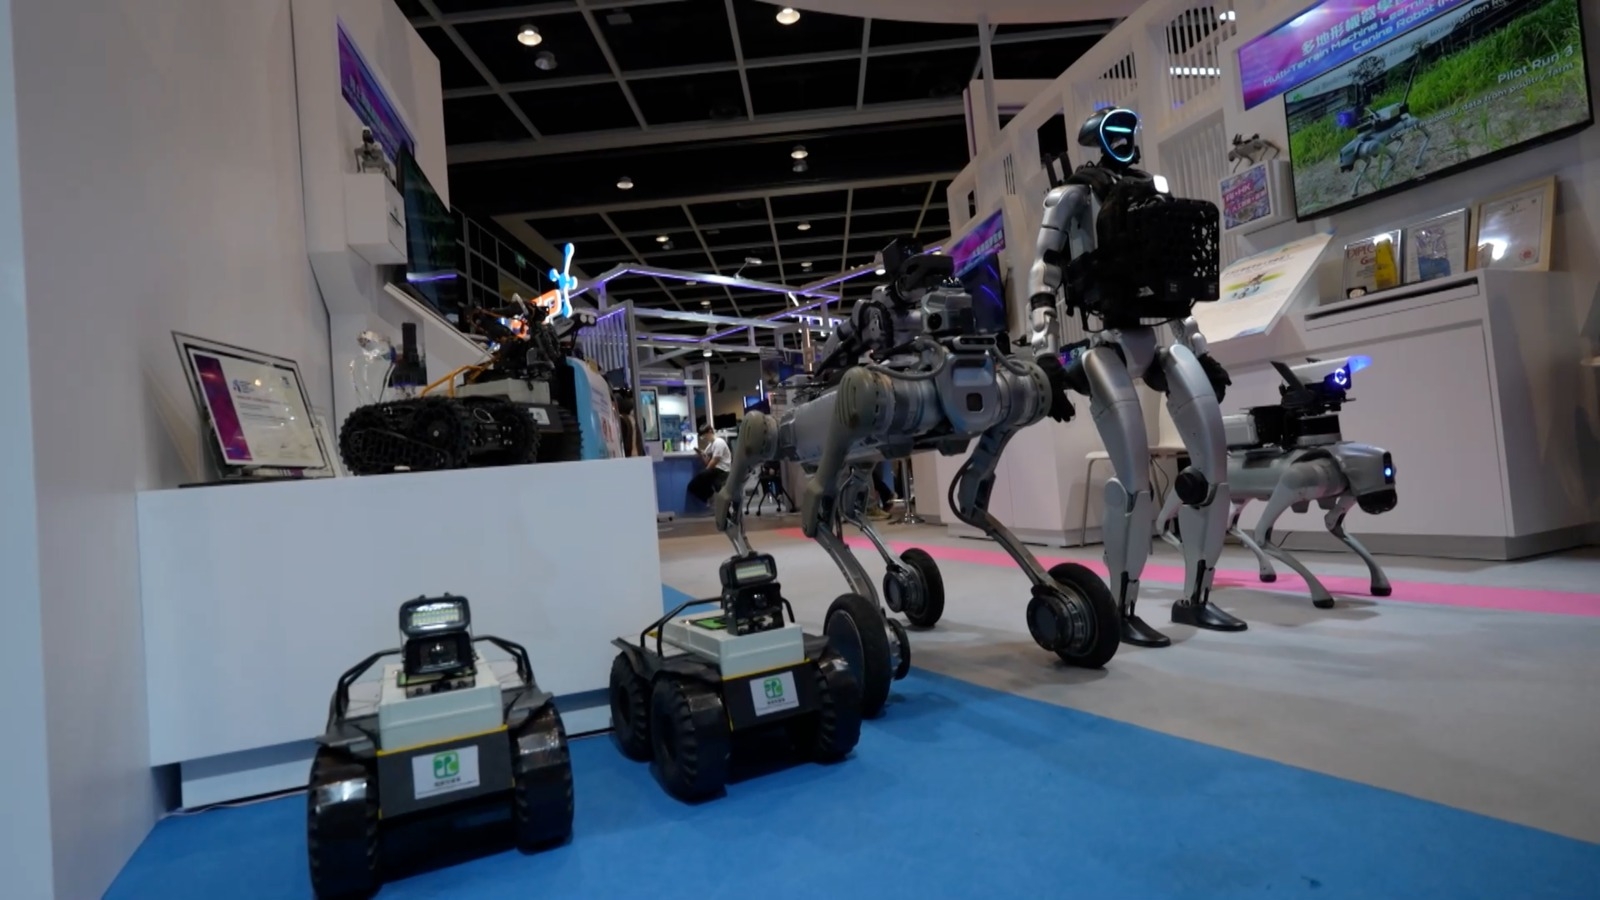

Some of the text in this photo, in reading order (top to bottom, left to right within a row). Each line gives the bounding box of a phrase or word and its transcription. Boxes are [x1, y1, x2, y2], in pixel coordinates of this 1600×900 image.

[1330, 22, 1378, 50] Machine
[1352, 26, 1393, 50] Canine
[1395, 4, 1435, 28] Robot
[1484, 89, 1507, 103] from
[1547, 62, 1574, 77] farm
[1497, 45, 1574, 83] Pilot Run 3
